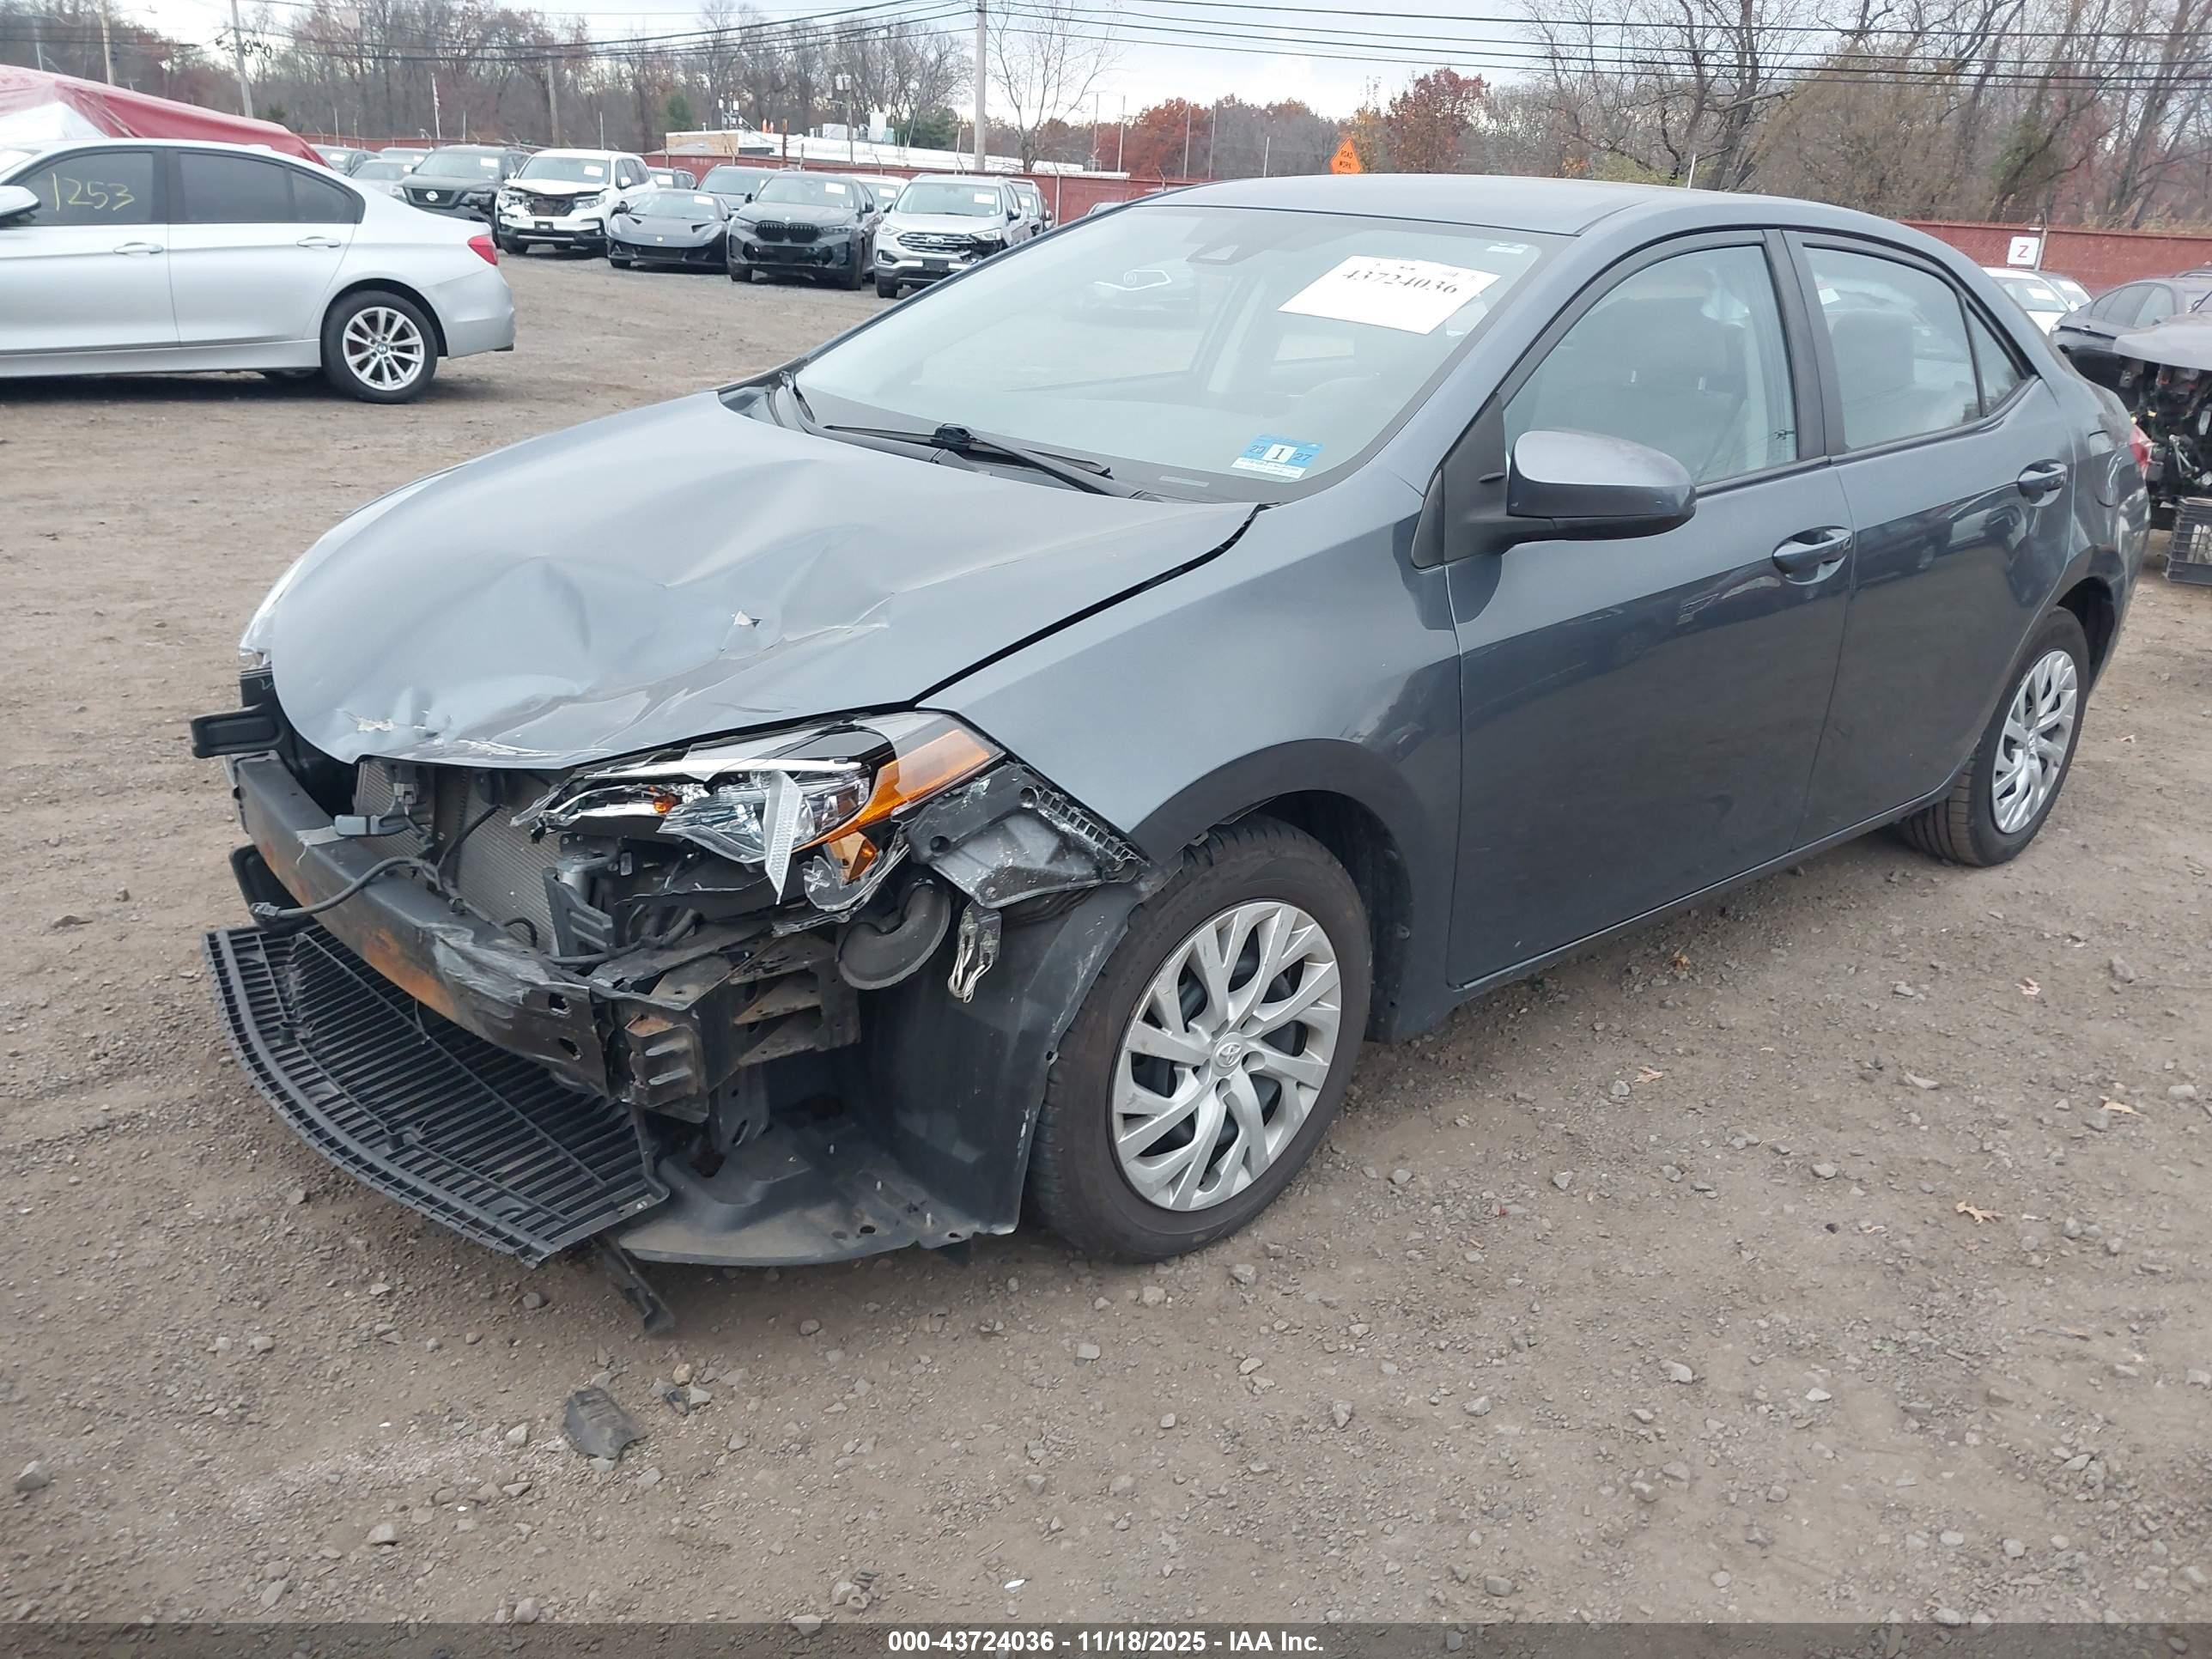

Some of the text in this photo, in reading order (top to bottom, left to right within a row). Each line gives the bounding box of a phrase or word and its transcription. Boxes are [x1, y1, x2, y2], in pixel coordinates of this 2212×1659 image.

[52, 173, 135, 211] 1253
[2017, 245, 2028, 258] Z
[1342, 270, 1458, 294] 43724036
[1272, 447, 1285, 460] 1
[1292, 453, 1313, 461] 27
